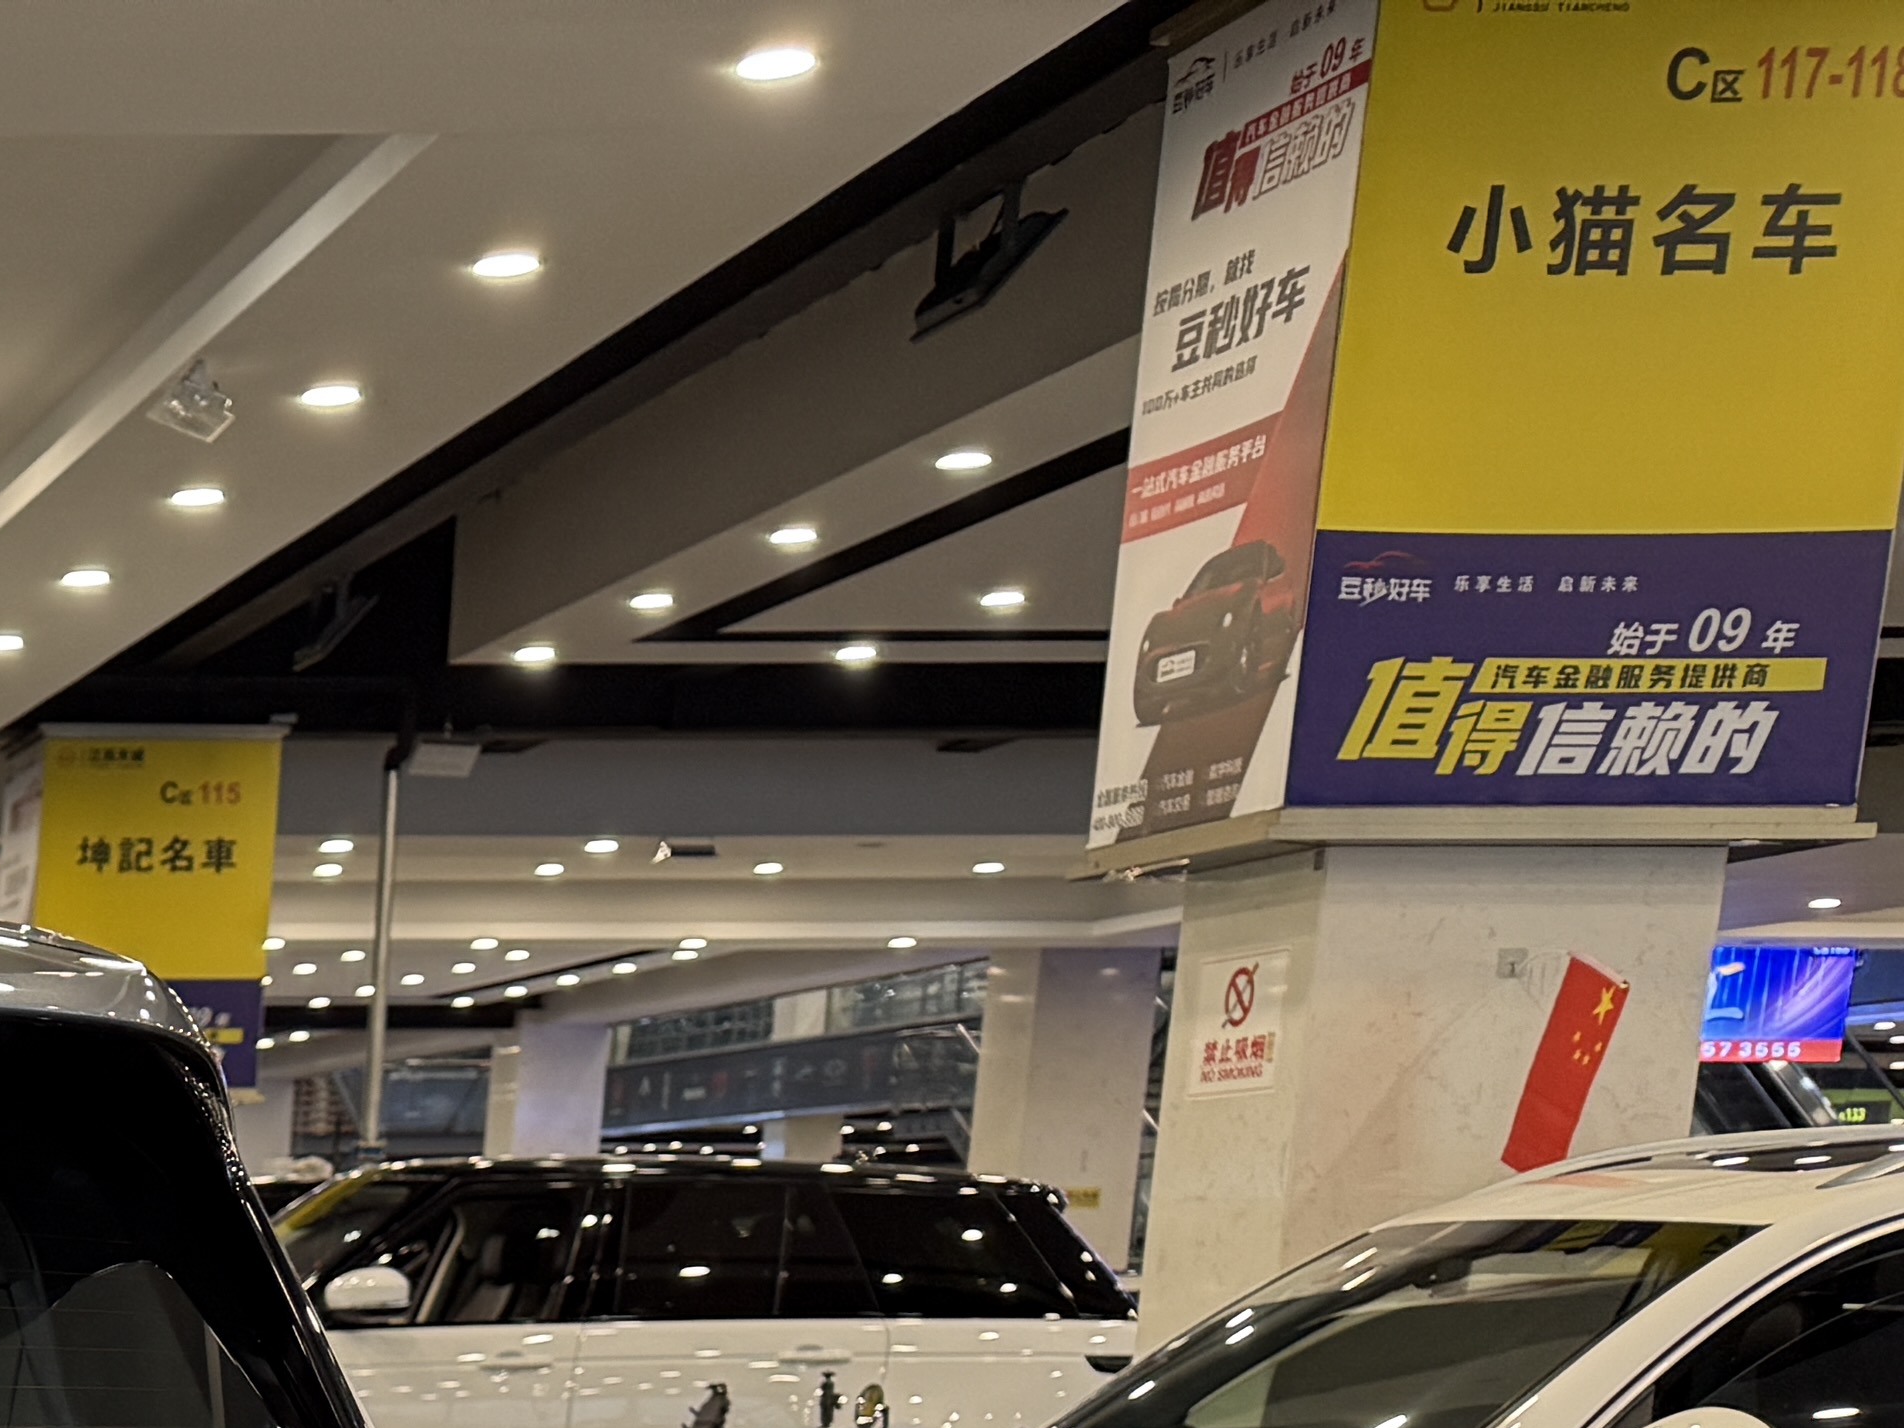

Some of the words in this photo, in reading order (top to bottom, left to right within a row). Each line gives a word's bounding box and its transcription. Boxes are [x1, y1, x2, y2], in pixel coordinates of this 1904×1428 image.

[1320, 37, 1347, 79] 09
[1666, 47, 1746, 103] C区
[1446, 182, 1843, 277] 小猫名车
[1170, 264, 1312, 373] 豆秒好车
[1454, 575, 1534, 593] 乐享生活
[1607, 621, 1679, 656] 始于
[1688, 607, 1753, 654] 09
[1761, 620, 1801, 654] 年
[1491, 662, 1771, 690] 汽车金融服务提供商
[1336, 656, 1780, 776] 值得信赖的
[198, 781, 241, 804] 115
[76, 834, 237, 875] 坤記名車
